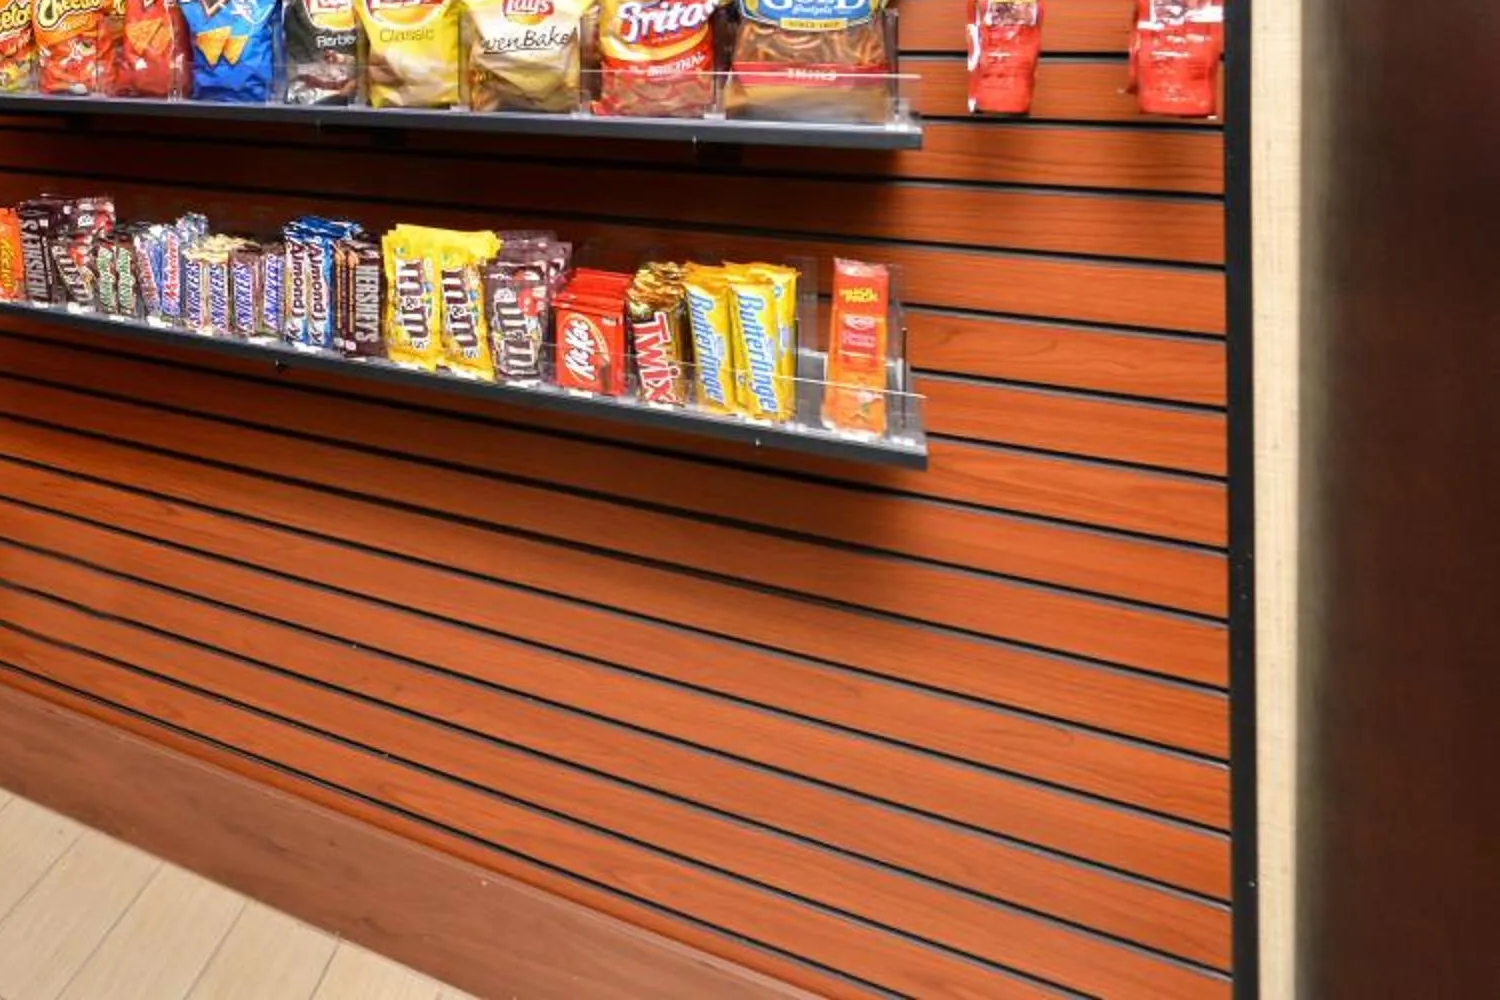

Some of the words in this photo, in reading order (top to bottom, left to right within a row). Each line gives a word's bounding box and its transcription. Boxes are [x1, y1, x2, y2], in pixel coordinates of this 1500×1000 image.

[379, 27, 435, 43] Classic
[291, 242, 307, 309] Almond
[308, 243, 326, 311] Almond
[355, 265, 380, 342] HERSHEY'S
